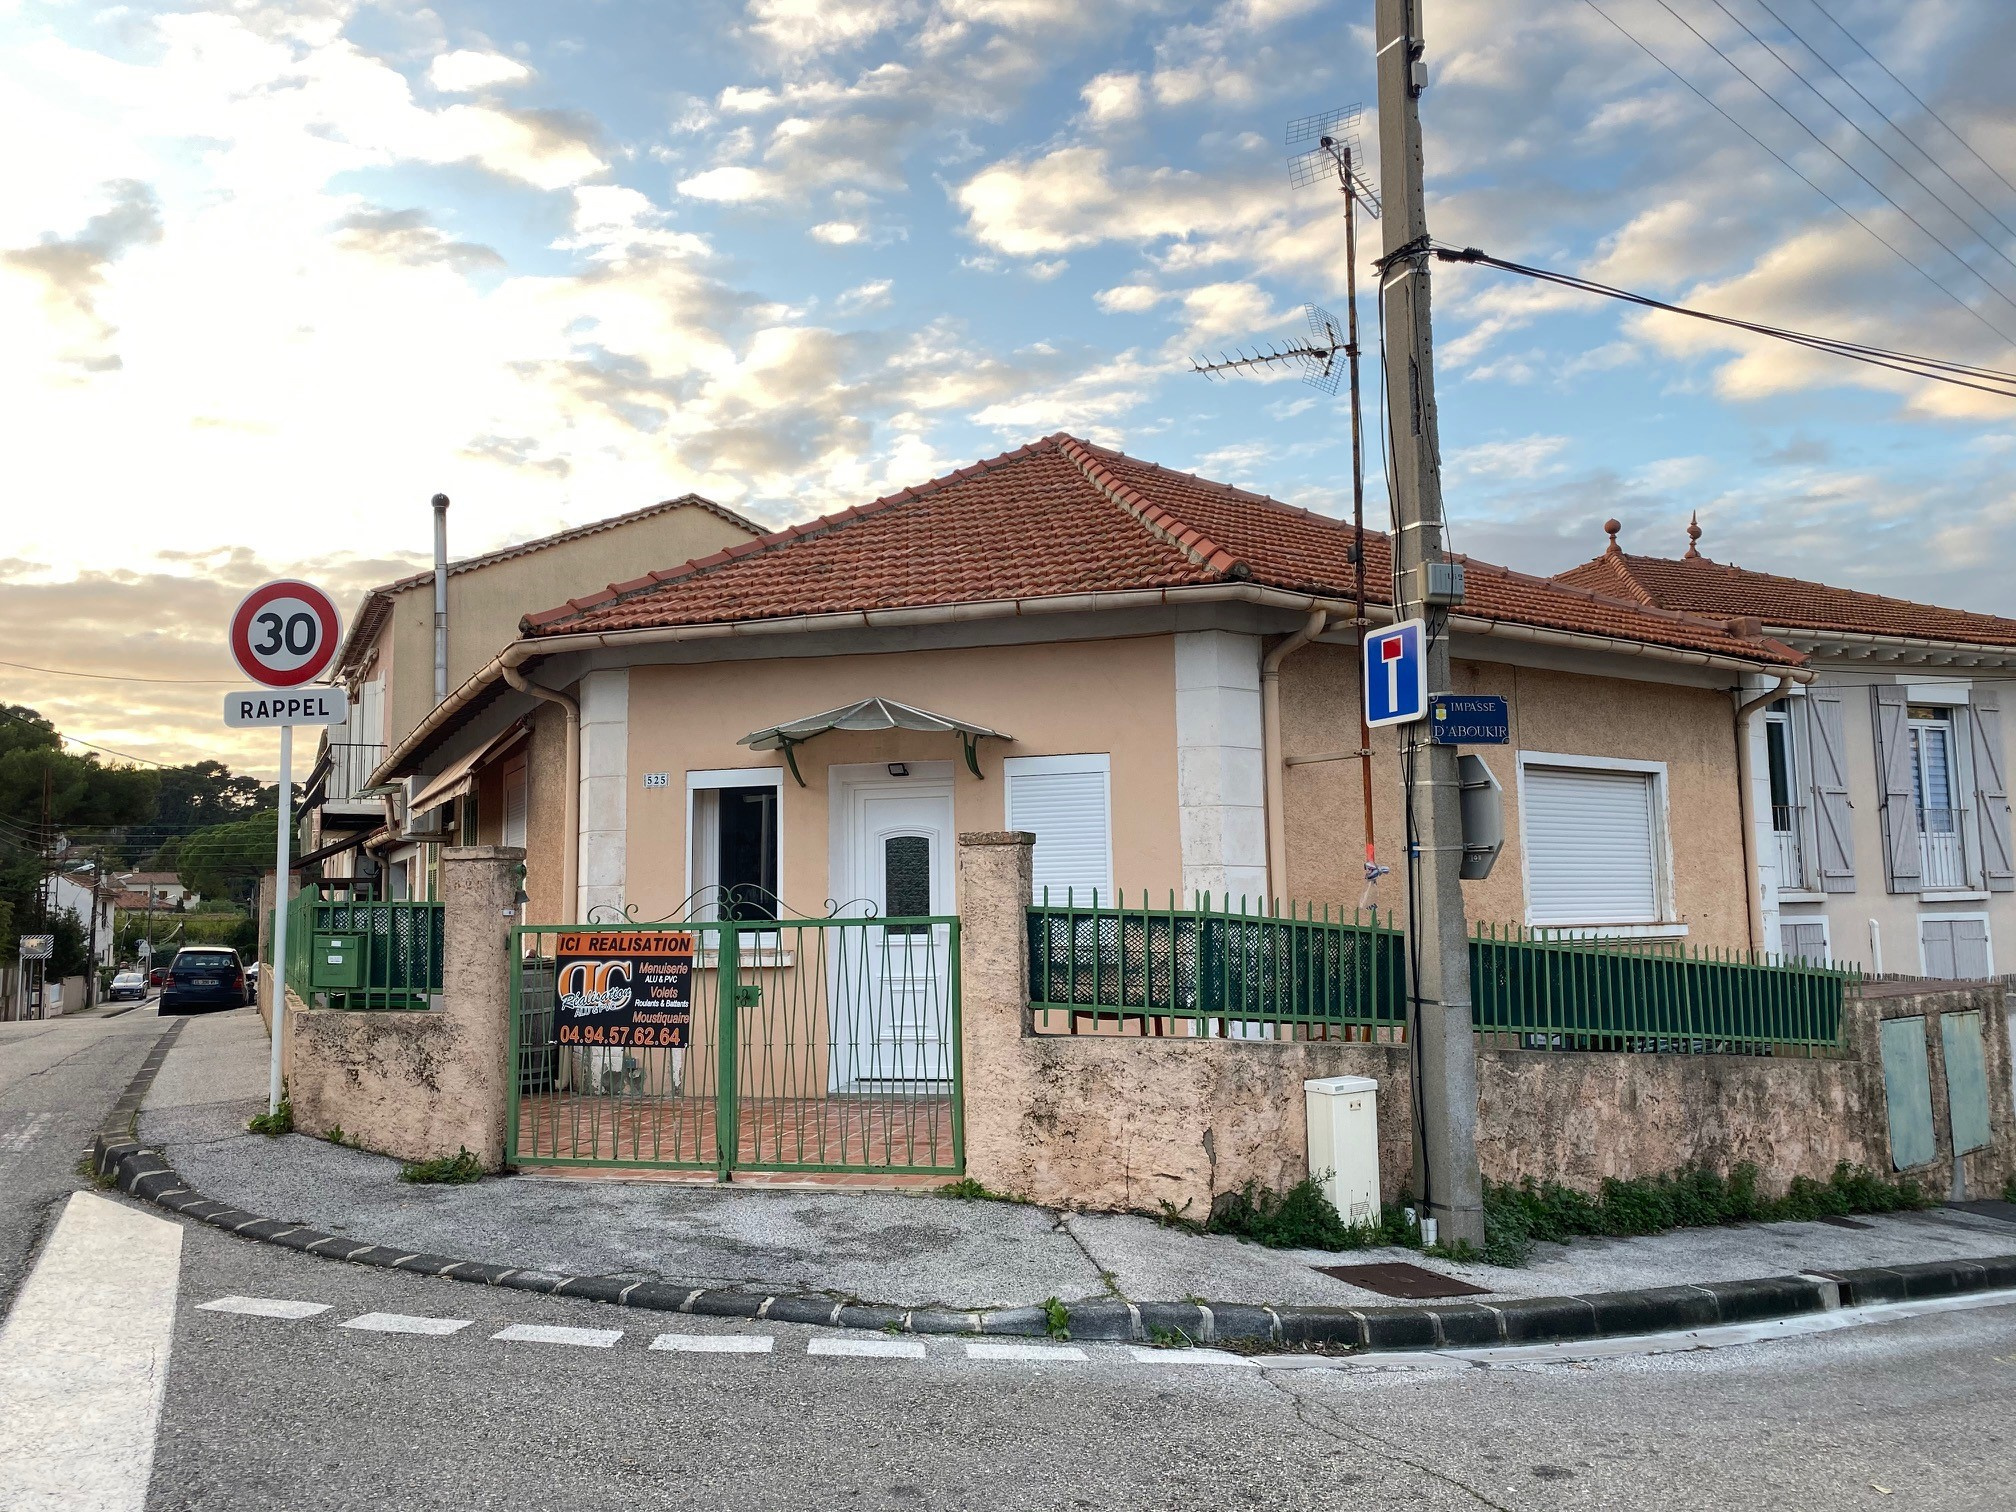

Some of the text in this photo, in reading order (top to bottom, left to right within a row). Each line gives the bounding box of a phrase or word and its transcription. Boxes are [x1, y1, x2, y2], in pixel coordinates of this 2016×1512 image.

[254, 612, 317, 656] 30
[241, 698, 330, 719] RAPPEL
[1451, 702, 1496, 712] IMPASSE
[647, 775, 666, 785] 525
[560, 937, 691, 952] ICI REALISATION
[639, 962, 688, 974] Menuiserie
[645, 975, 678, 984] ALU & PVC
[650, 986, 678, 998] Volets
[634, 998, 689, 1008] Roulants & Battants
[632, 1010, 690, 1026] Moustiquaire
[560, 1025, 681, 1046] 04.94.57.62.64
